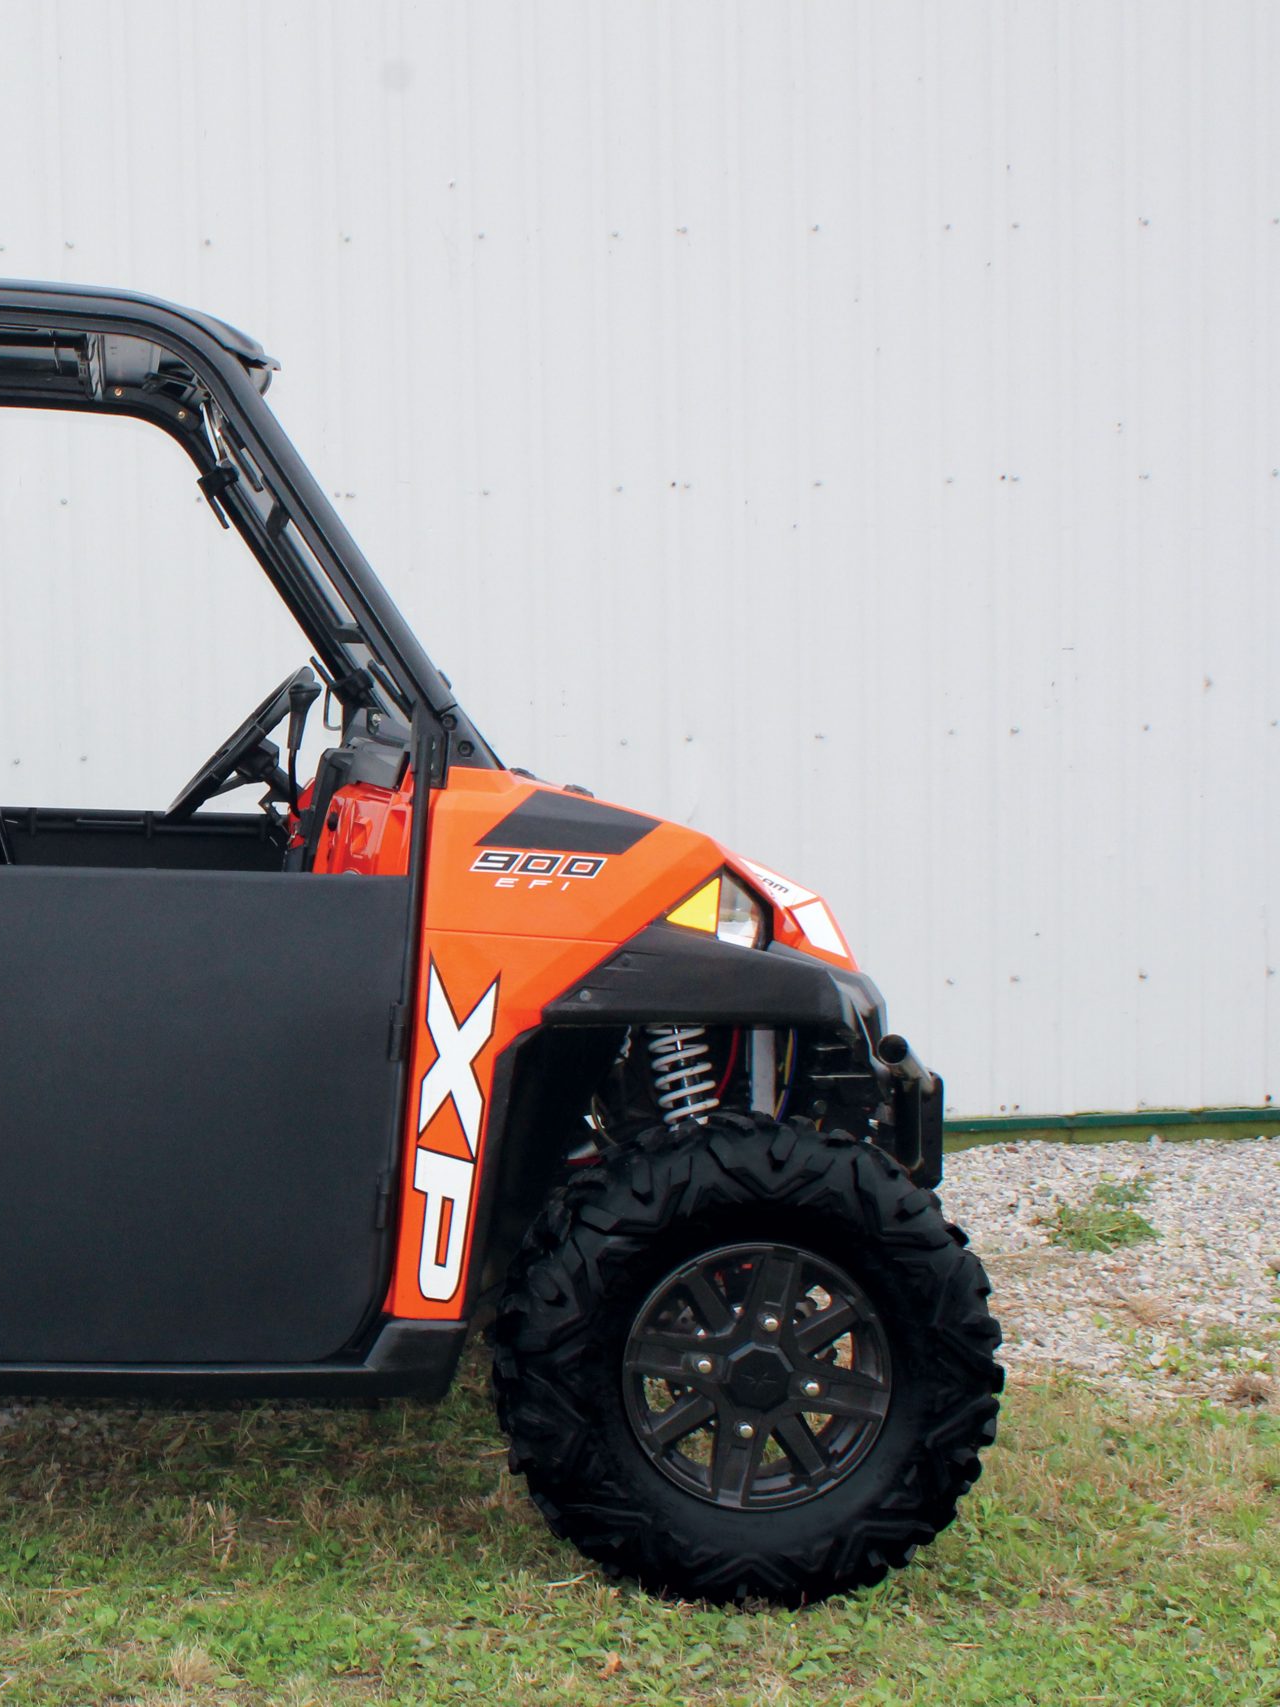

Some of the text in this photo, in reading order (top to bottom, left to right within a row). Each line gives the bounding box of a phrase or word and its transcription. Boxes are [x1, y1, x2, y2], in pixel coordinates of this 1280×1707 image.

[469, 850, 608, 879] 900
[494, 877, 571, 891] EFI
[413, 949, 501, 1303] XP
